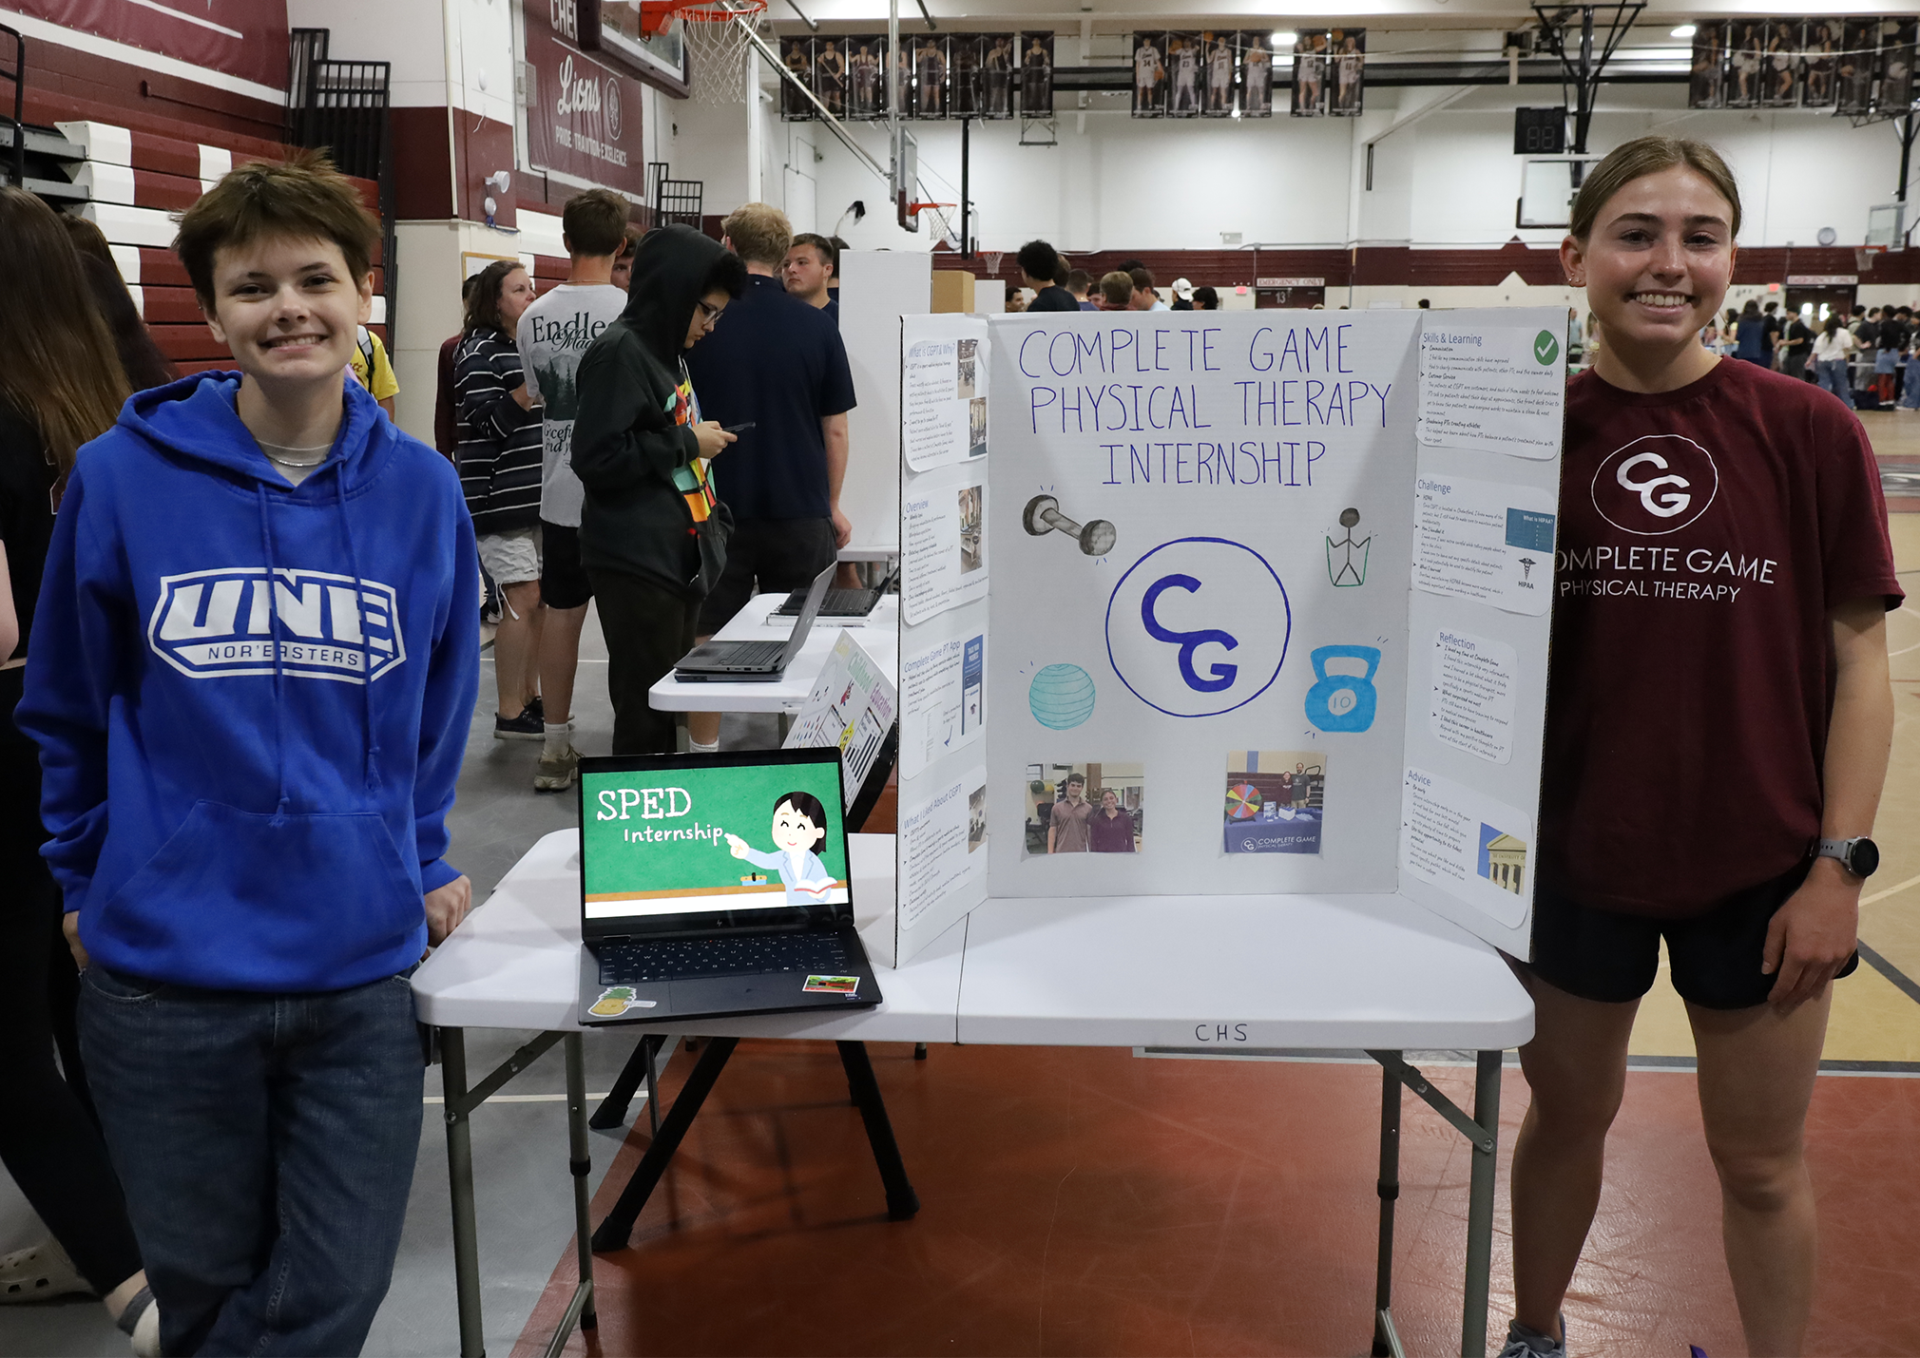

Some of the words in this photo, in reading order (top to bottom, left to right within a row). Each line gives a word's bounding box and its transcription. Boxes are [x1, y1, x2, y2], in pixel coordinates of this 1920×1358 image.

[557, 54, 602, 115] Lions
[1303, 279, 1323, 287] ONLY
[1275, 291, 1286, 304] 13
[531, 311, 613, 344] Endle
[1423, 332, 1440, 344] Skills
[1441, 333, 1447, 344] &
[1448, 333, 1483, 347] Learning
[1018, 328, 1222, 378] COMPLETE
[1249, 324, 1354, 373] GAME
[1030, 383, 1212, 435] PHYSICAL
[1233, 379, 1392, 428] THERAPY
[1099, 441, 1326, 487] INTERNSHIP
[1417, 479, 1451, 495] Challenge
[1616, 451, 1691, 518] CG
[905, 499, 929, 514] Overview
[1556, 546, 1680, 573] OMPLETE
[1685, 548, 1778, 585] GAME
[1518, 581, 1534, 590] HIPAA
[1560, 579, 1649, 597] PHYSICAL
[1653, 580, 1741, 603] THERAPY
[159, 579, 394, 653] UNE
[1140, 573, 1239, 693] CG
[1439, 631, 1476, 651] Reflection
[904, 656, 930, 673] Complete
[930, 648, 943, 660] Game
[942, 644, 950, 655] PT
[869, 681, 892, 722] Education
[1332, 696, 1352, 709] 10
[1408, 770, 1432, 787] Advice
[597, 787, 692, 821] SPED
[624, 822, 723, 847] Internship
[1257, 836, 1295, 845] COMPLETE
[1195, 1023, 1248, 1042] CHS
